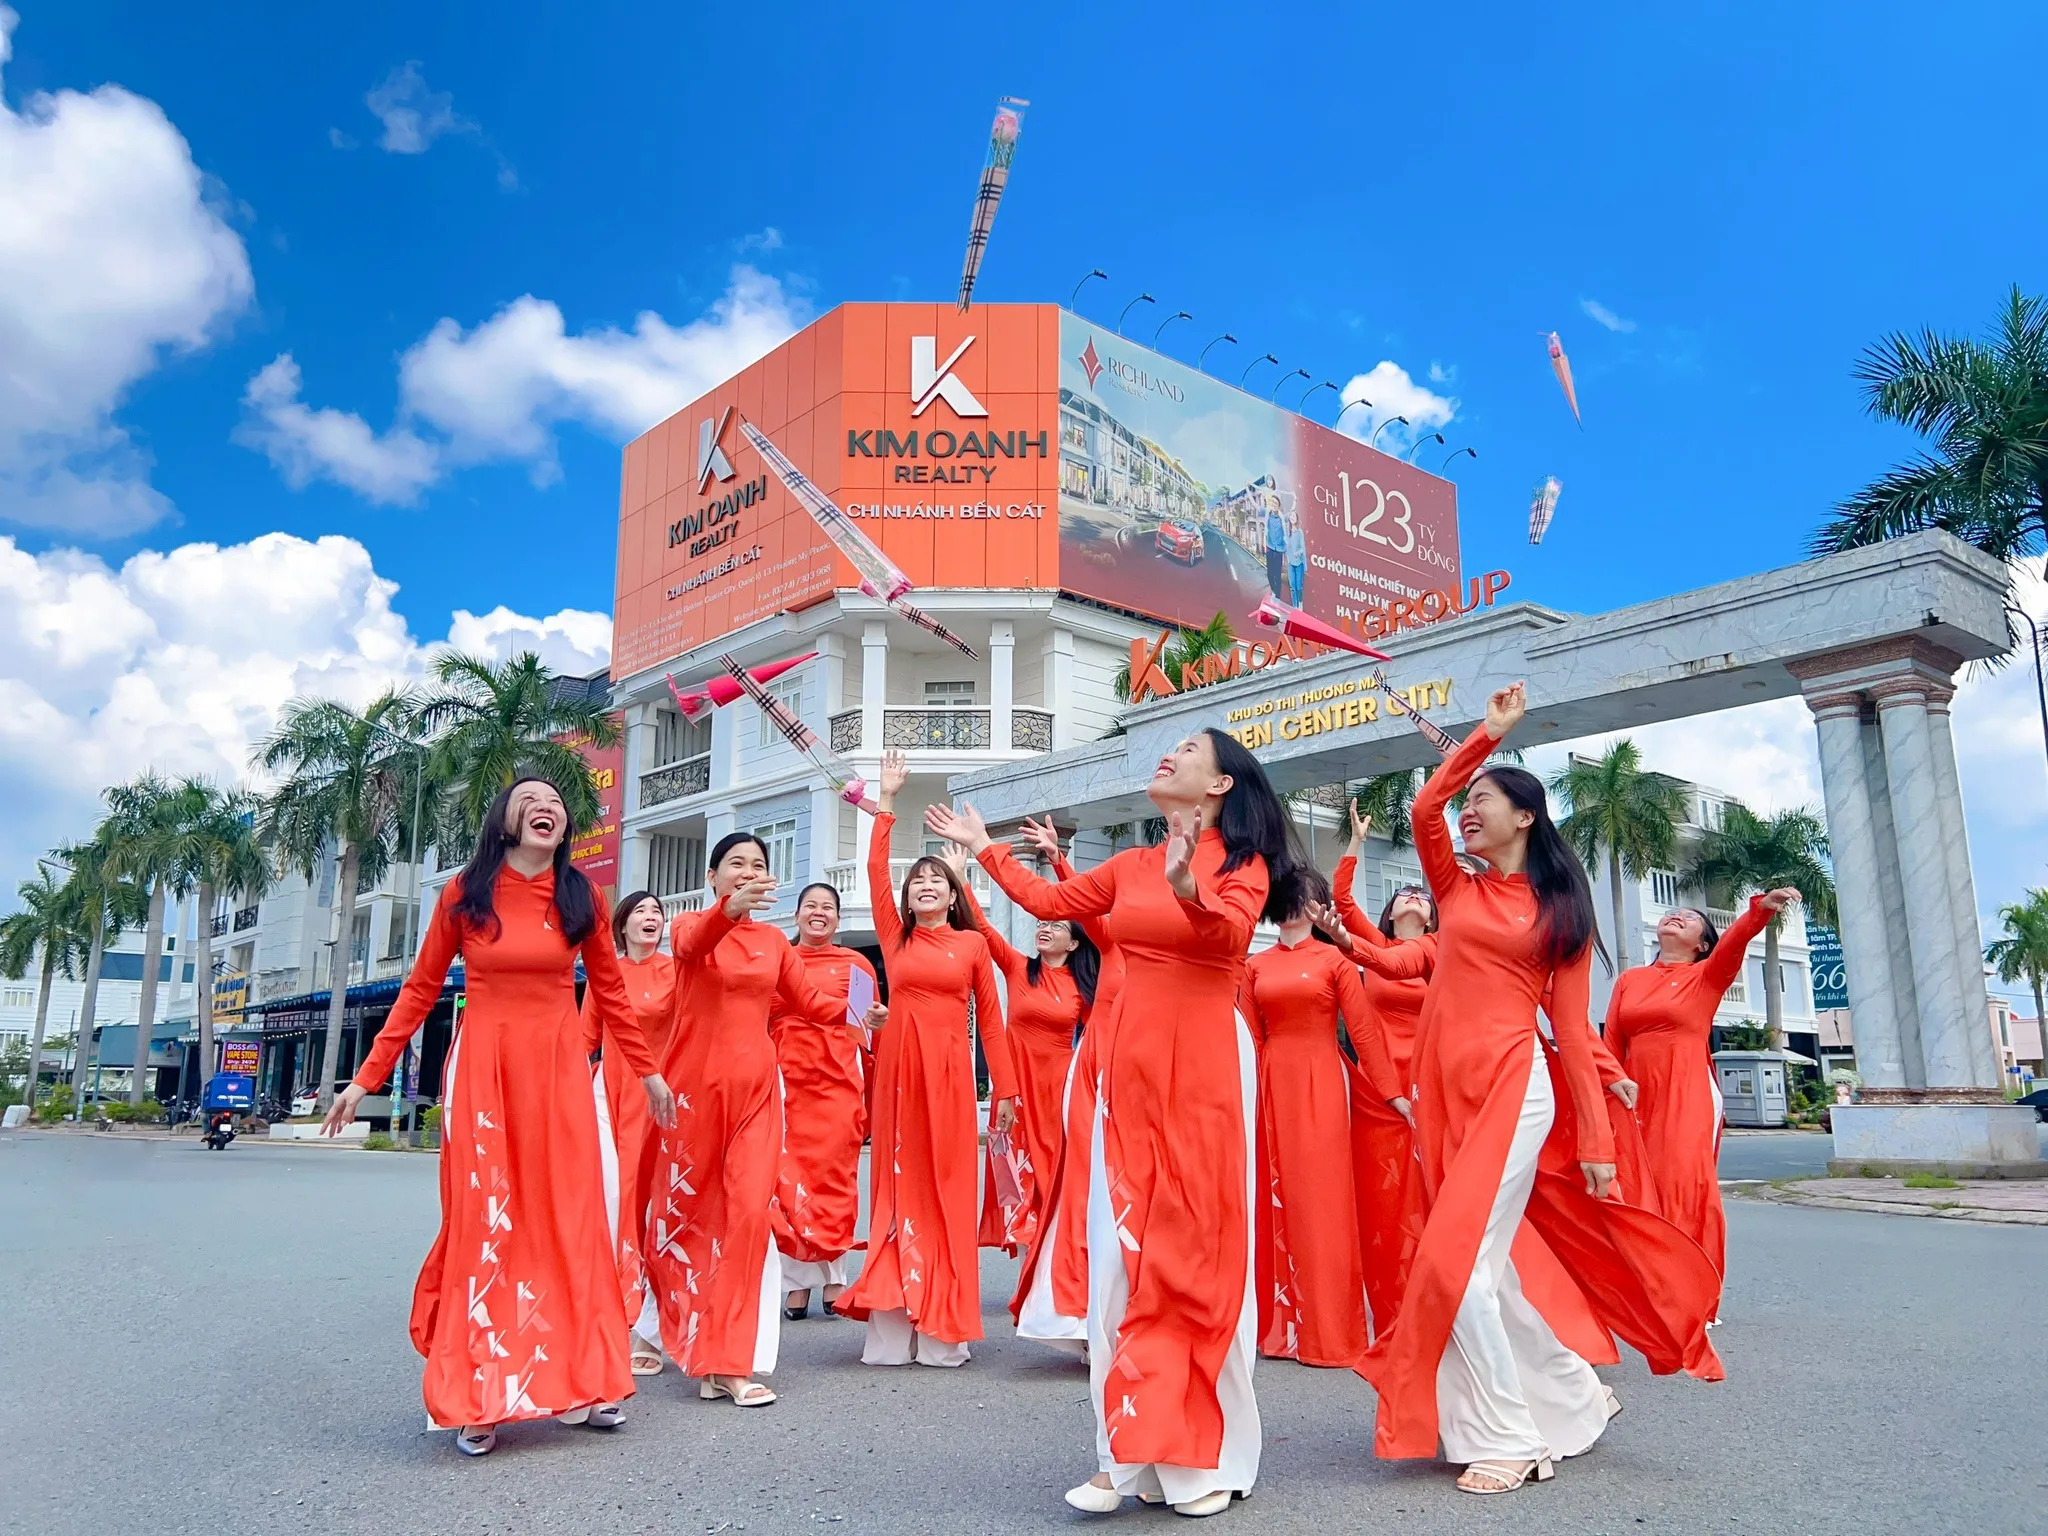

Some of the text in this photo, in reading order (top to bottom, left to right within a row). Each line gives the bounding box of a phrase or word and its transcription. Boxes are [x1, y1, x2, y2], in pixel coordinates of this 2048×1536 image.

[1108, 357, 1185, 403] RICHLAND
[848, 429, 1047, 458] KIM OANH
[895, 465, 997, 483] REALTY
[668, 474, 767, 549] KIM OANH
[846, 499, 1046, 520] CHI NHÁNH BẾN CÁT
[1338, 471, 1415, 554] 1,23
[690, 520, 740, 558] REALTY
[665, 588, 682, 601] CHI
[682, 569, 718, 593] NHÁNH
[1327, 559, 1347, 576] HỘI
[1348, 565, 1377, 586] NHẬN
[1339, 584, 1368, 603] PHÁP
[1182, 647, 1240, 690] KIM
[1357, 570, 1511, 639] GROUP
[1227, 704, 1252, 723] KHU
[1254, 698, 1274, 716] ĐÔ
[1275, 694, 1297, 712] THỊ
[1278, 695, 1378, 741] CENTER
[1385, 676, 1452, 716] CITY
[226, 1051, 258, 1059] VAPE STORE
